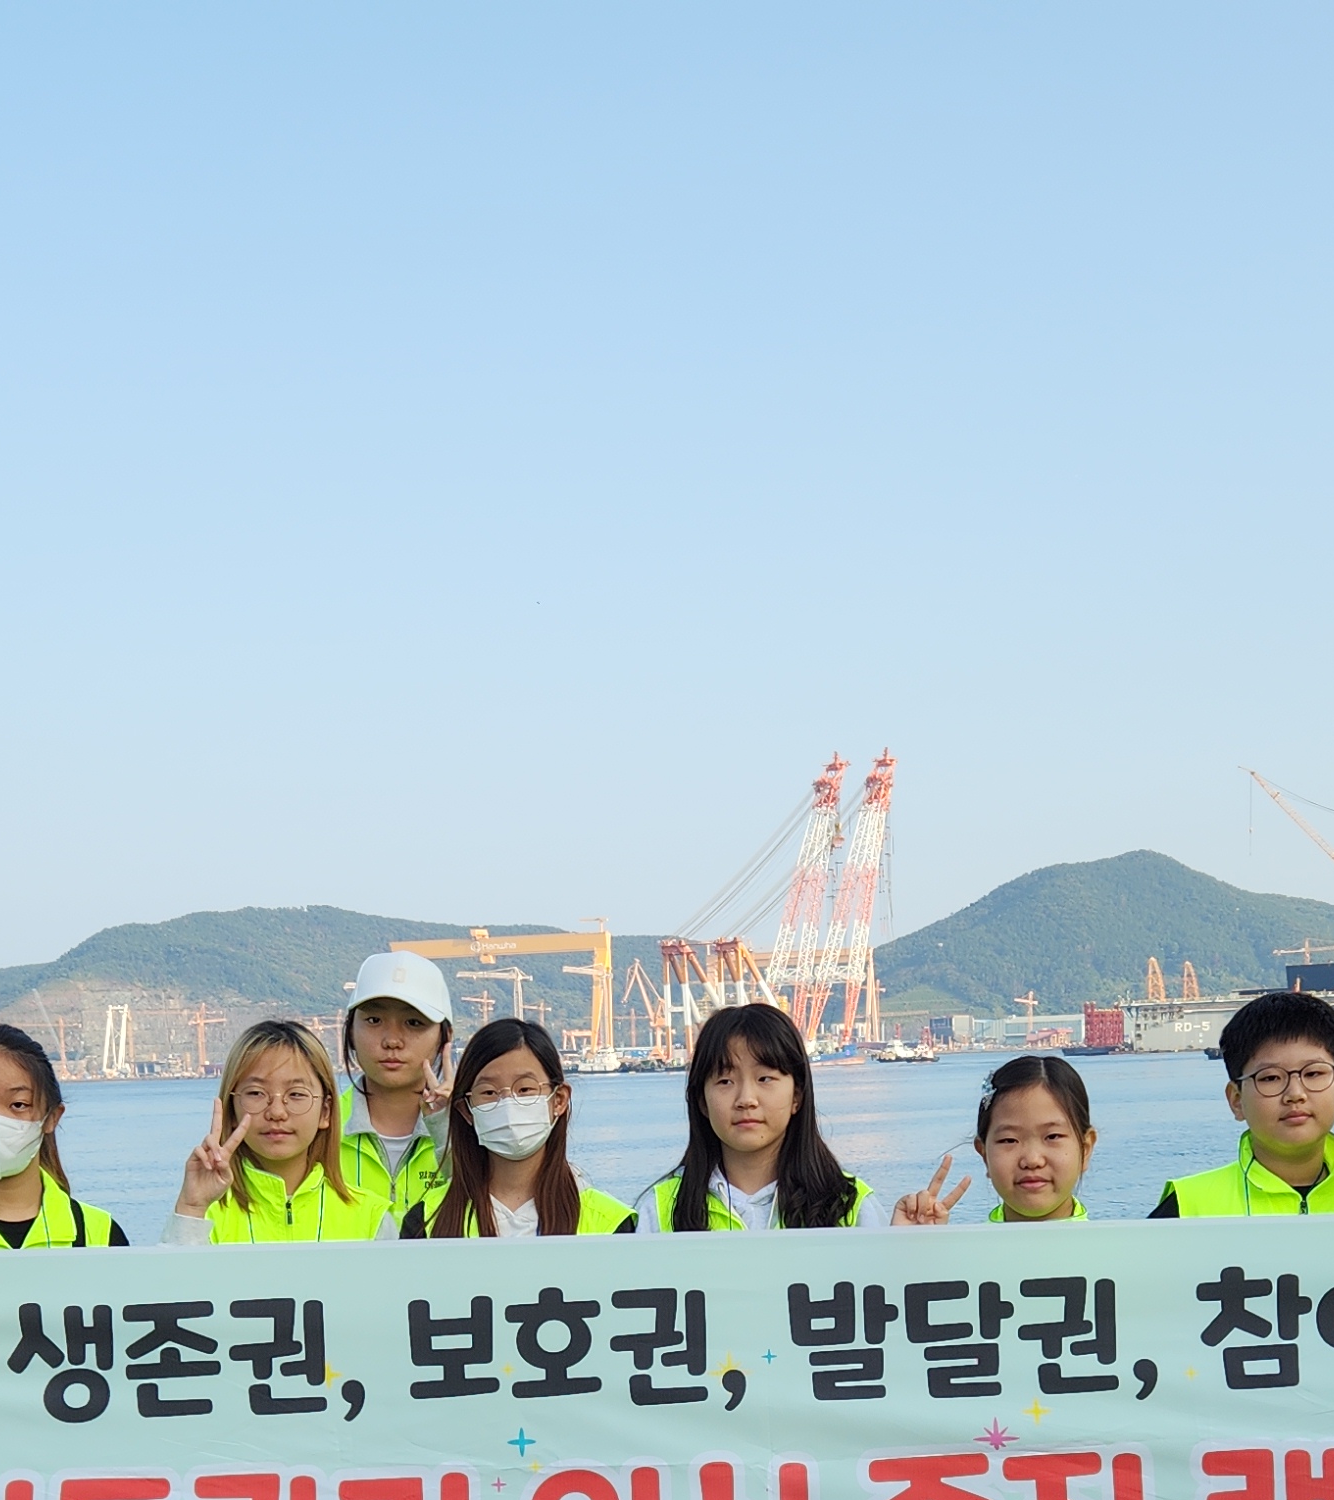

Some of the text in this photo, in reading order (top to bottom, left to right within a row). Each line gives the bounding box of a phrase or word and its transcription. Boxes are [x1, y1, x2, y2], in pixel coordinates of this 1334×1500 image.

[481, 942, 517, 951] Hanwha
[1174, 1021, 1211, 1033] RD-5
[7, 1298, 366, 1424] 생존권,
[407, 1287, 747, 1412] 보호권,
[787, 1276, 1158, 1400] 발달권,
